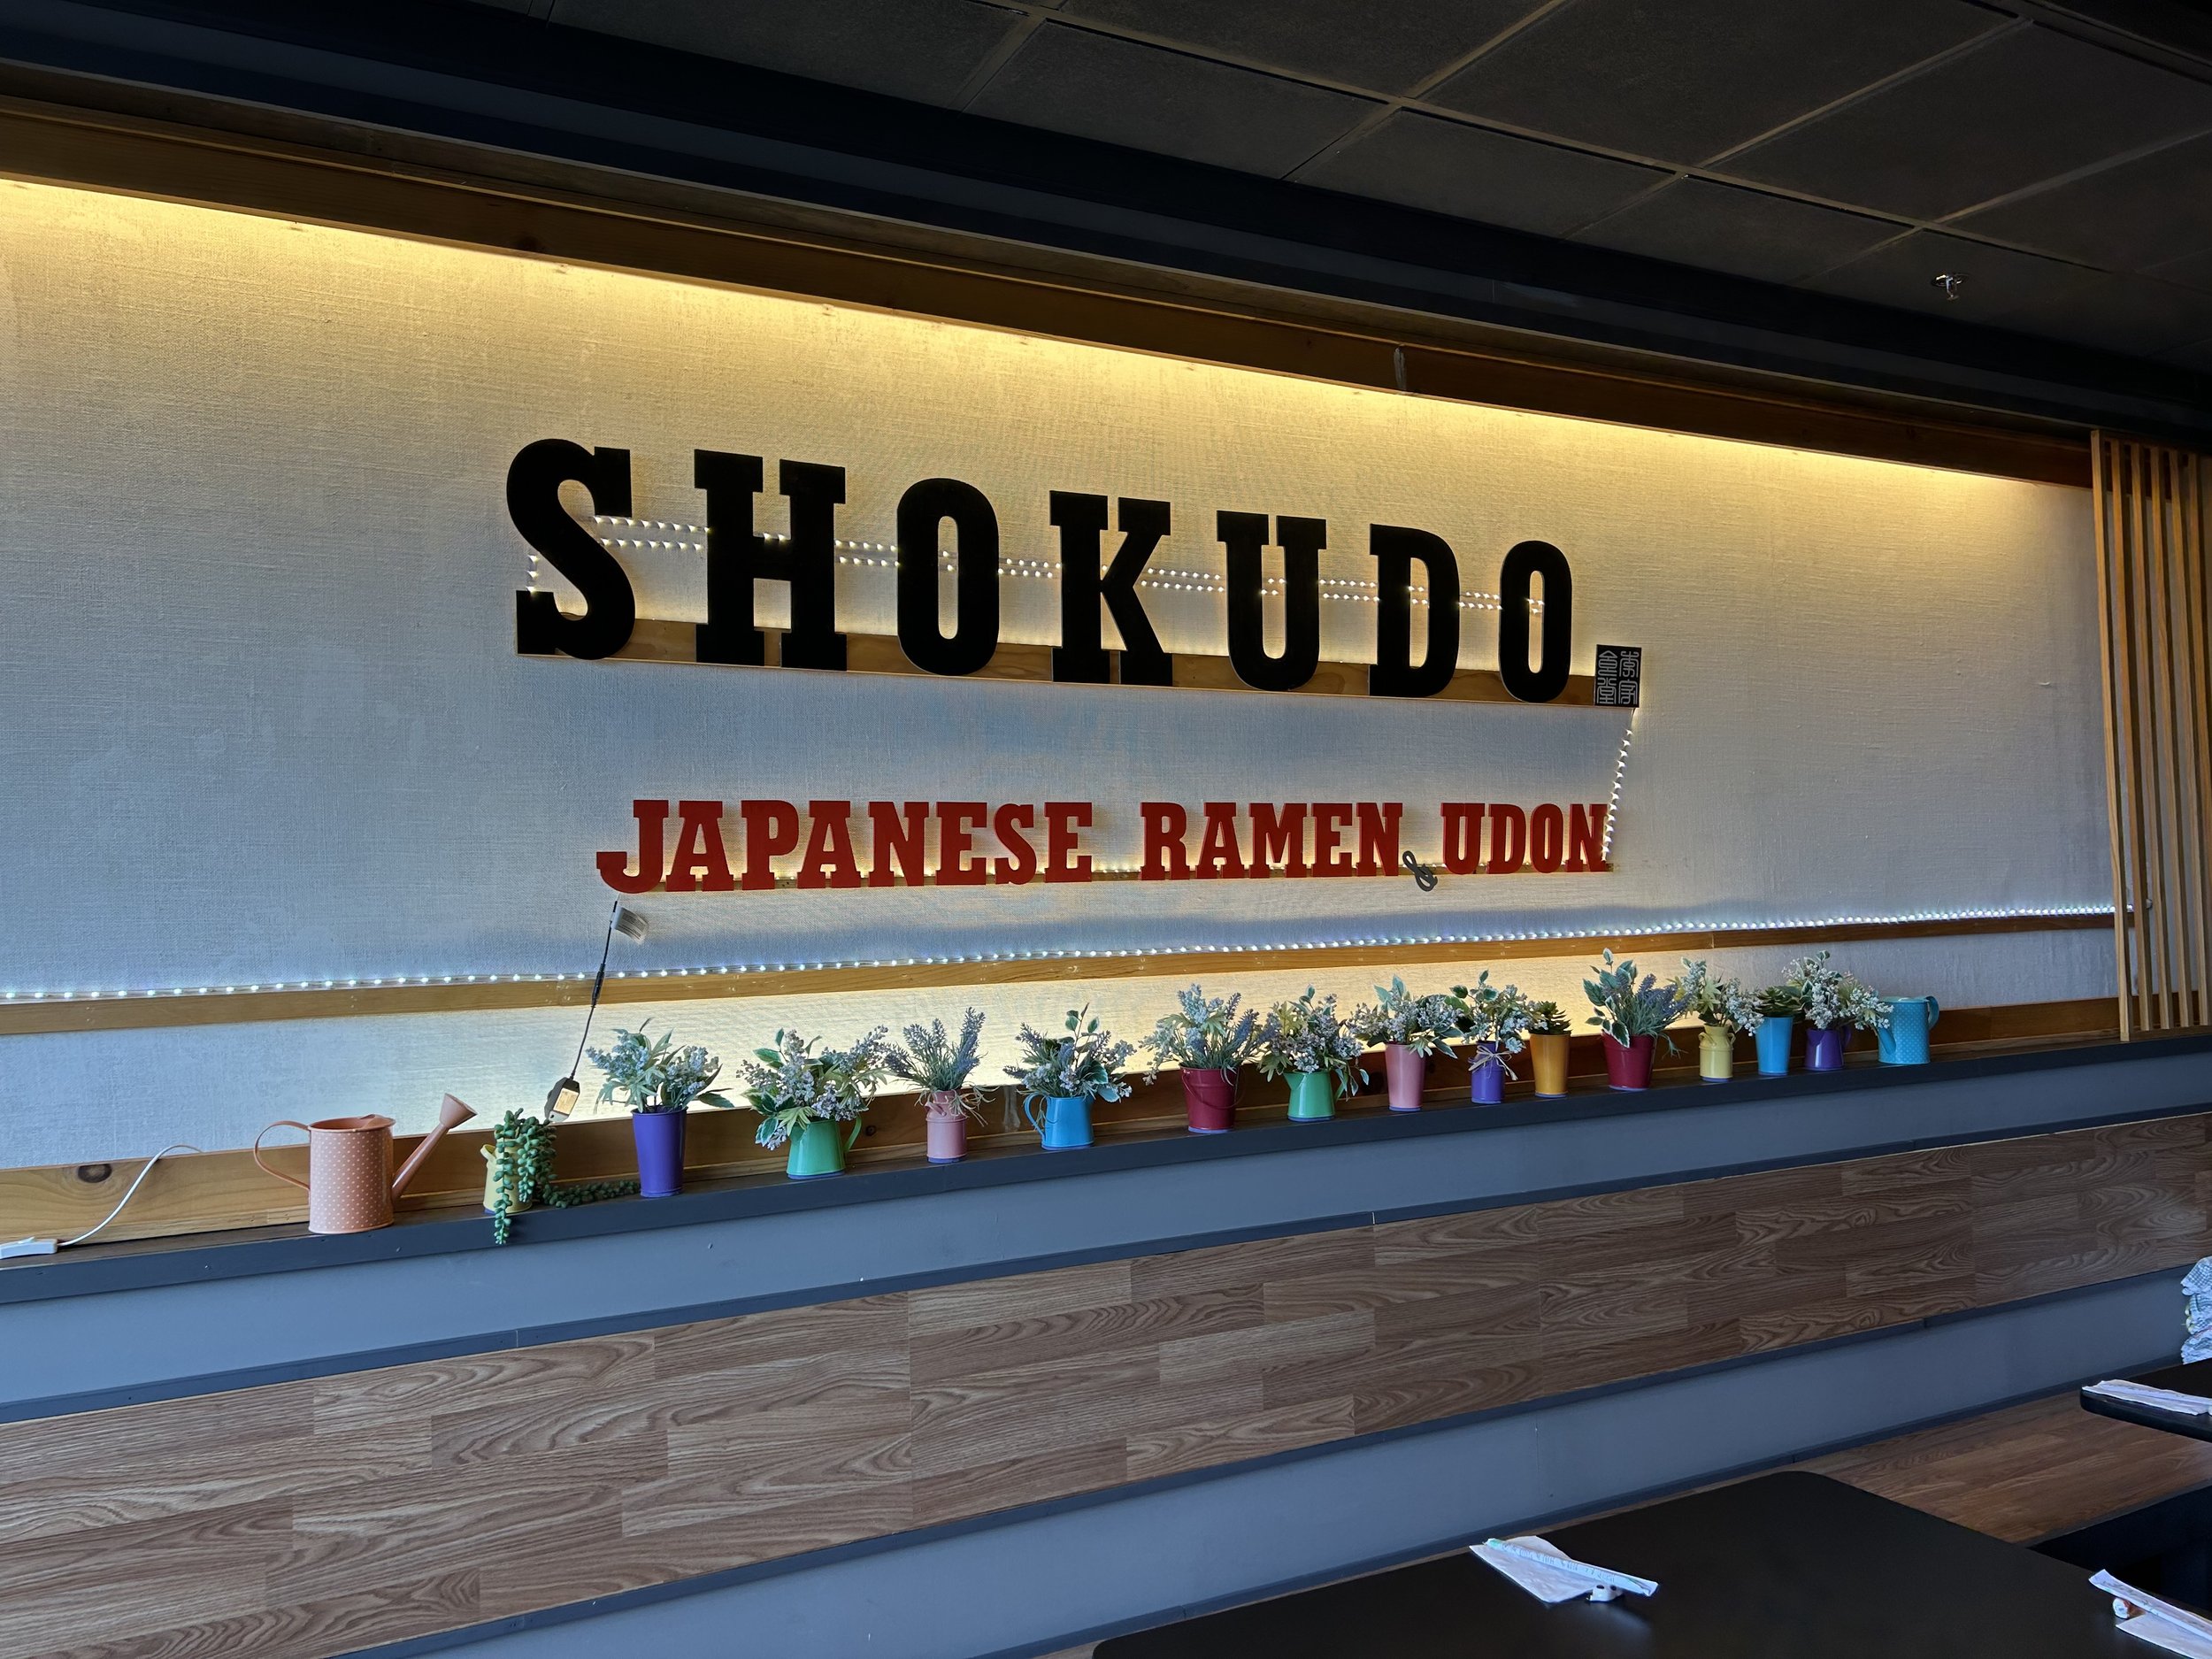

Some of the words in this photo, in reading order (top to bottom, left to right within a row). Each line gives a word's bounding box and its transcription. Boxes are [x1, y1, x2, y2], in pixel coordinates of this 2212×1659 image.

[507, 439, 1572, 703] SHOKUDO
[596, 799, 1093, 894] JAPANESE
[1141, 802, 1403, 881] RAMEN
[1402, 850, 1438, 892] &
[1440, 803, 1609, 875] UDON
